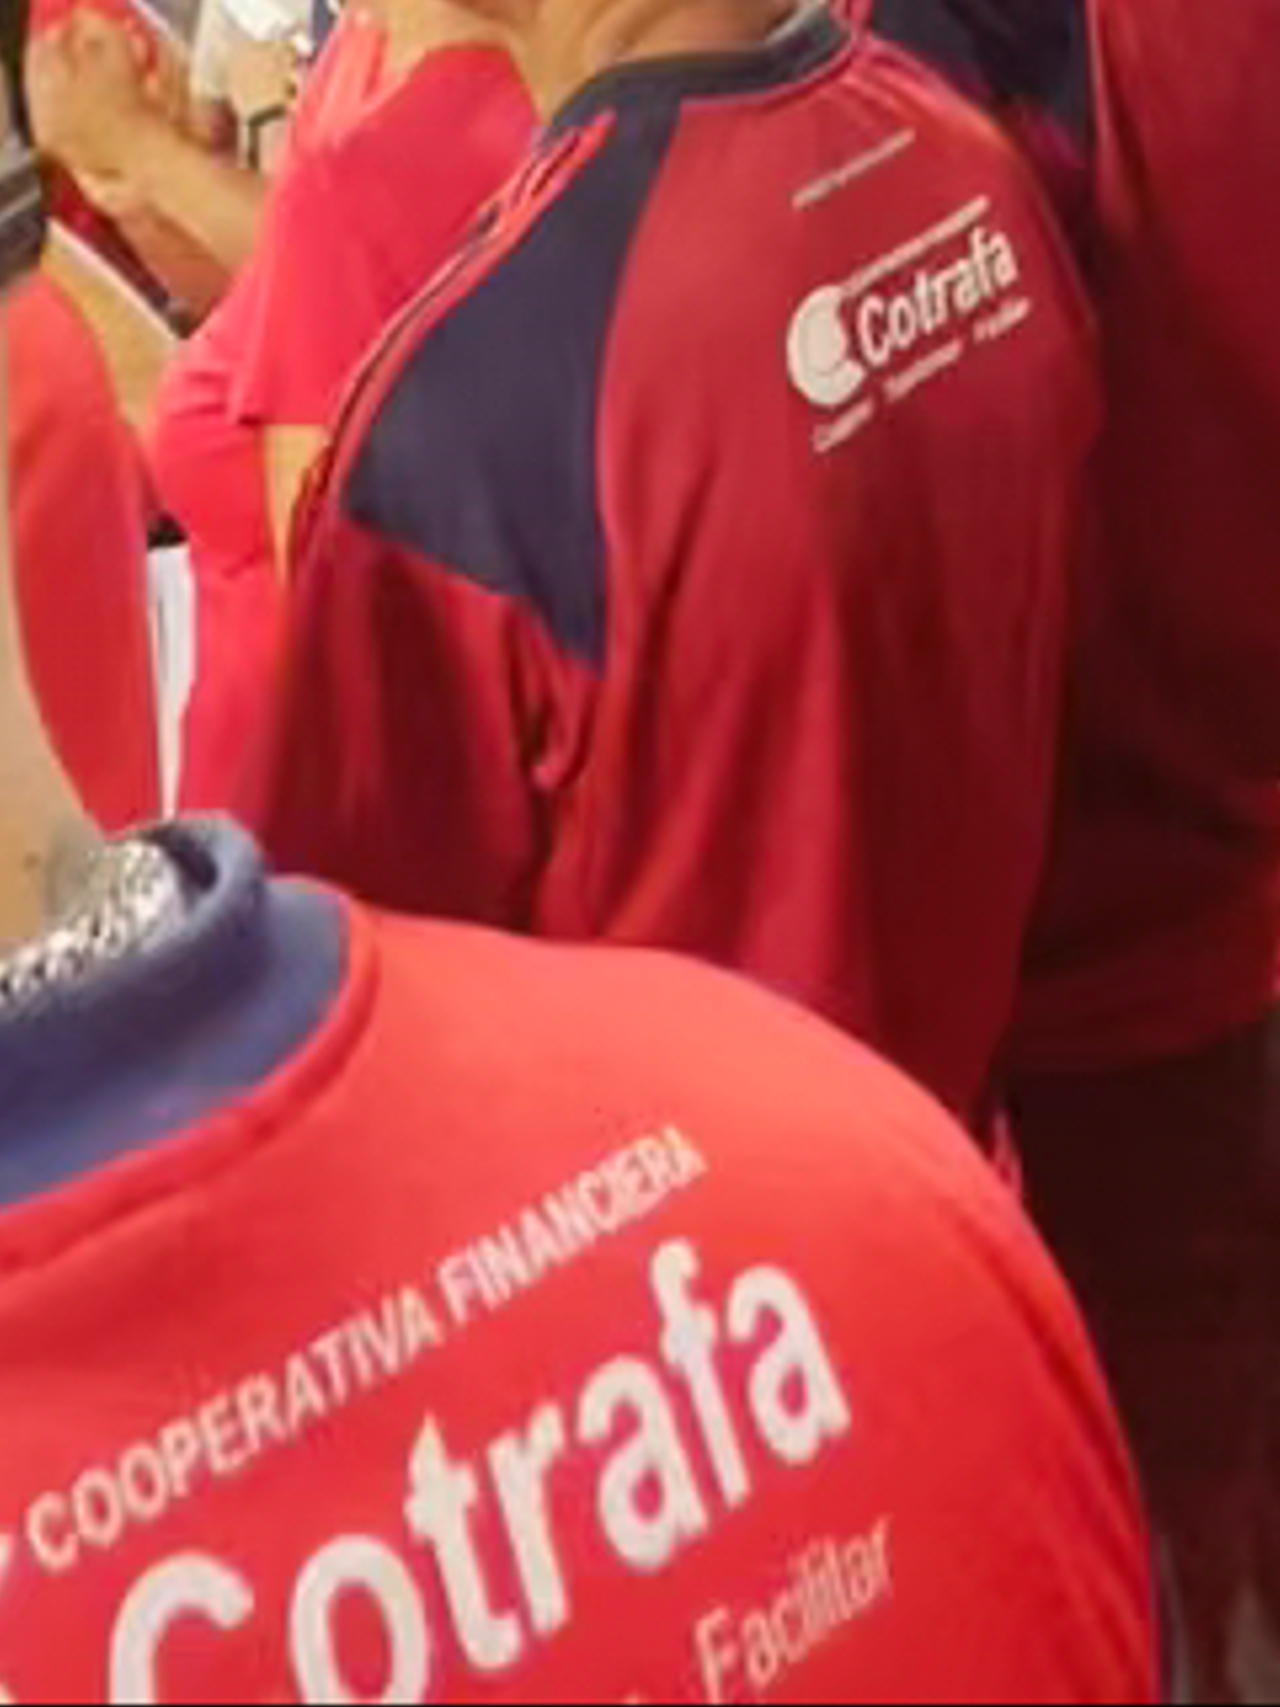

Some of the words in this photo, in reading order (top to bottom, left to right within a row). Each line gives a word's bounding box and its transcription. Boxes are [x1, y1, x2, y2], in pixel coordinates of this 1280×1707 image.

[858, 226, 1020, 367] Cotrafa
[27, 1285, 443, 1571] COOPERATIVA
[436, 1125, 707, 1329] FINANCIERA
